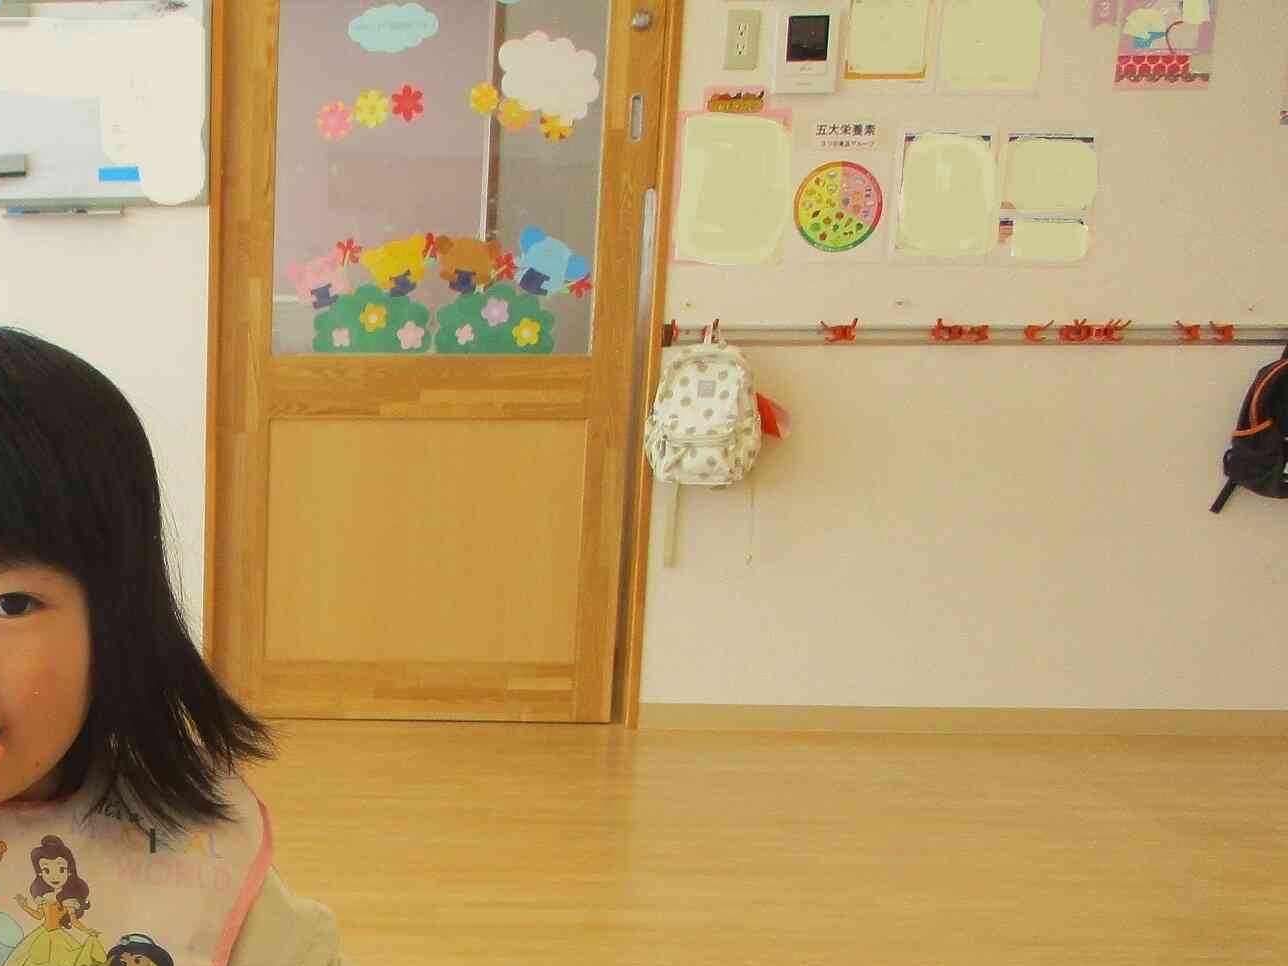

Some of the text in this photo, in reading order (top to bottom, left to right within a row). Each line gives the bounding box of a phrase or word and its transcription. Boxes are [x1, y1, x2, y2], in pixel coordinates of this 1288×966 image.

[816, 123, 876, 136] 五大栄養素
